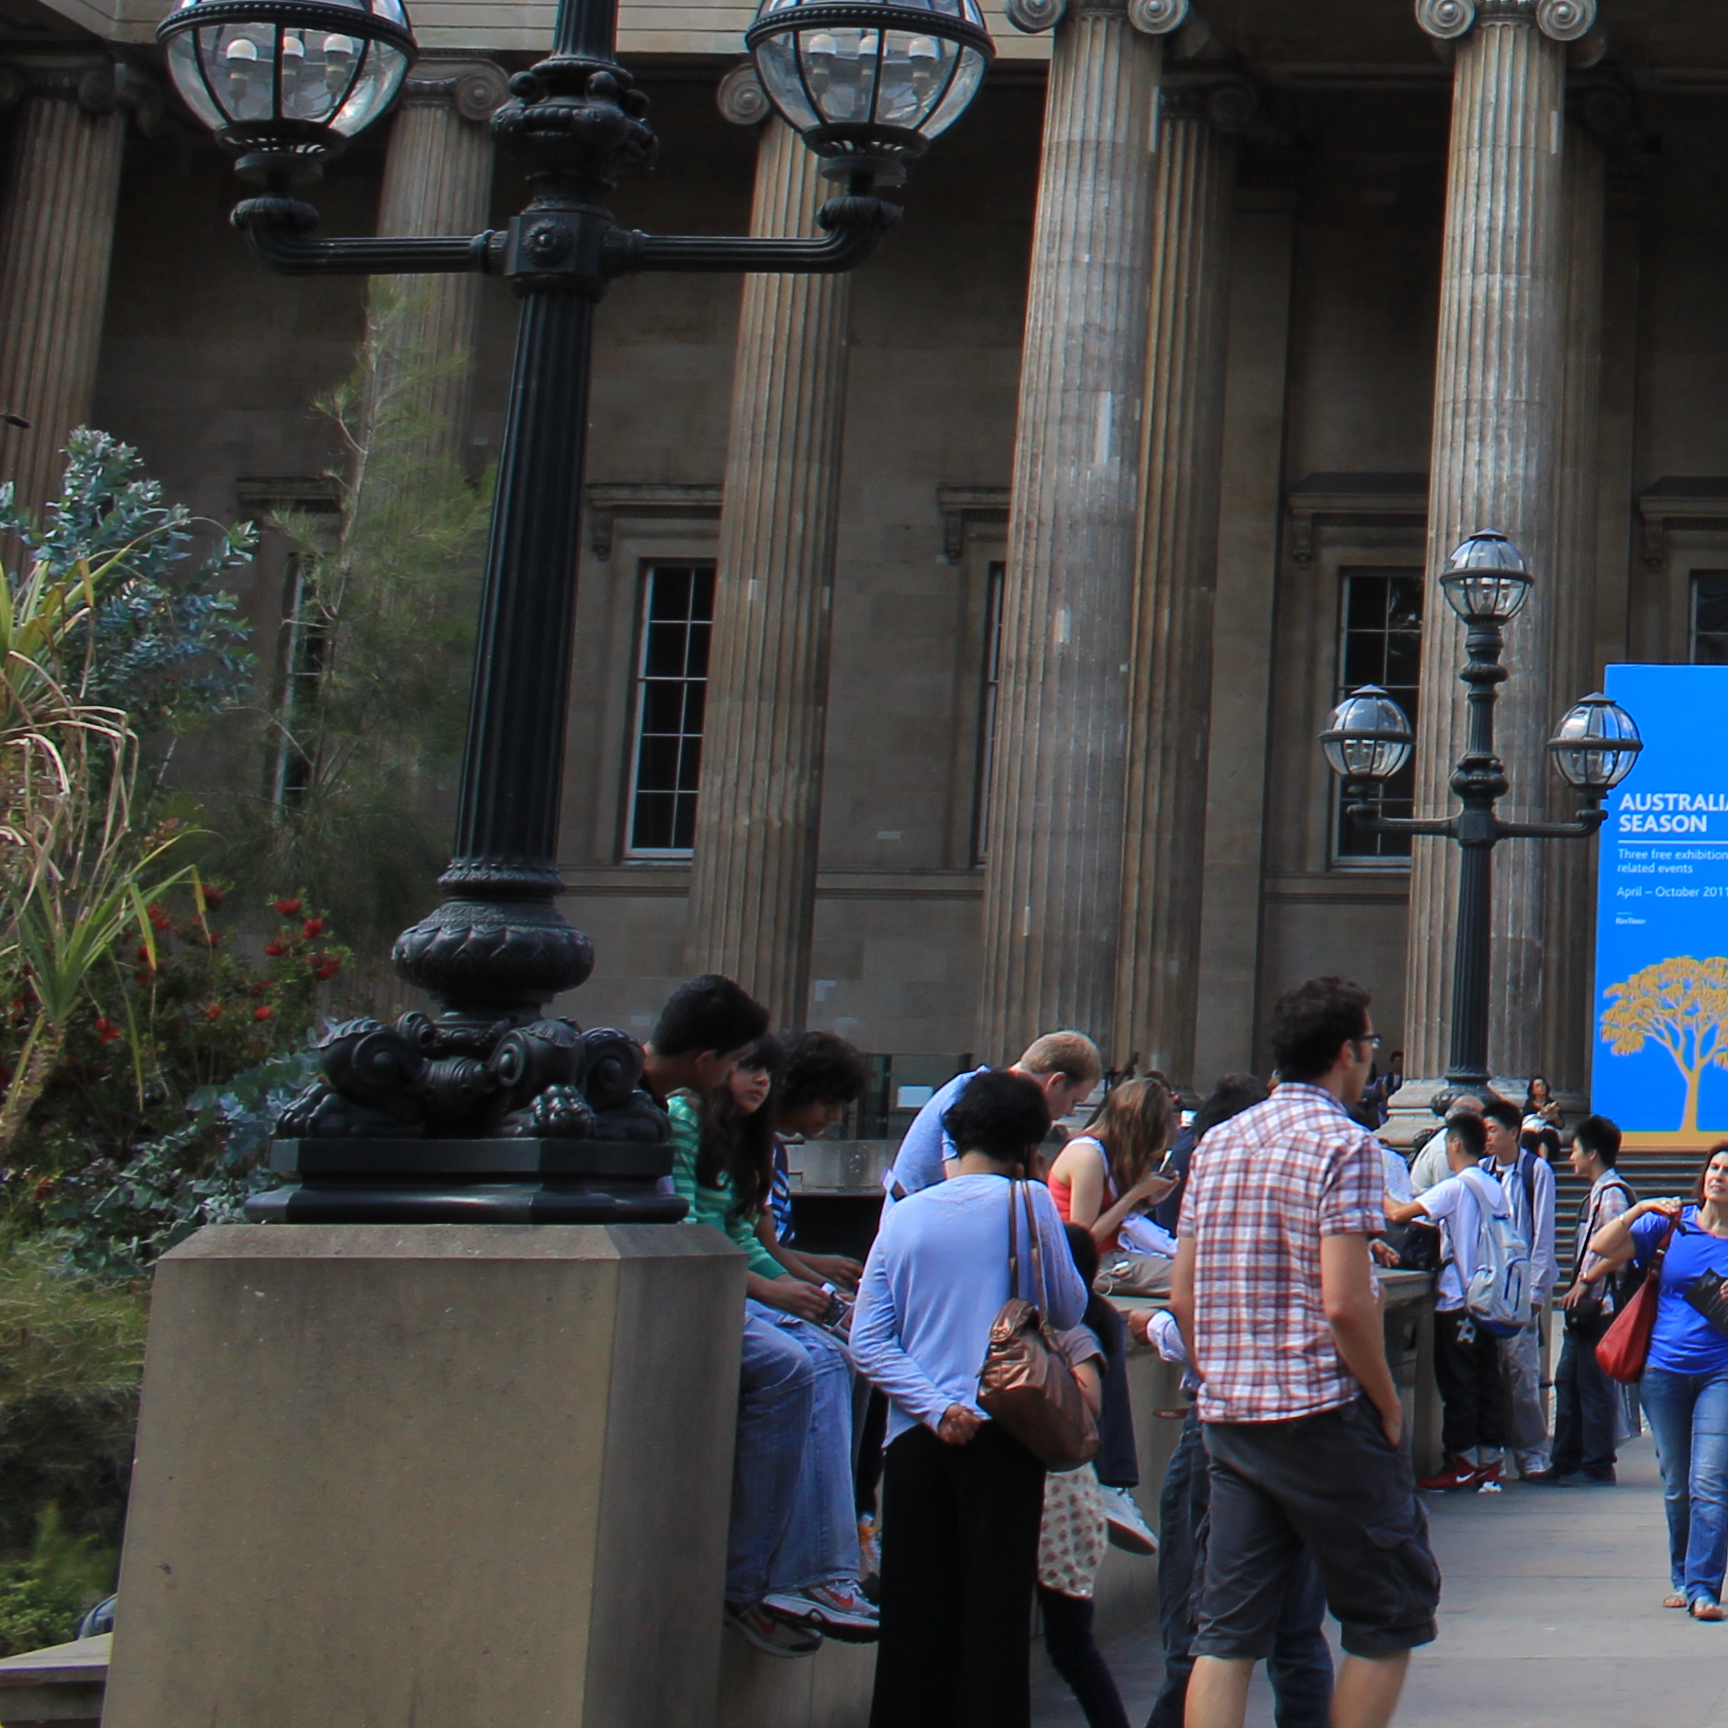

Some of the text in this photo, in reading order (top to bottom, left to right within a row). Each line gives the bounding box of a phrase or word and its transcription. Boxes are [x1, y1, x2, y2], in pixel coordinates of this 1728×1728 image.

[1618, 814, 1707, 833] SEASON
[1618, 848, 1648, 860] Three
[1651, 848, 1672, 860] free
[1617, 862, 1693, 873] related events
[1616, 886, 1642, 899] April
[1655, 886, 1700, 897] October
